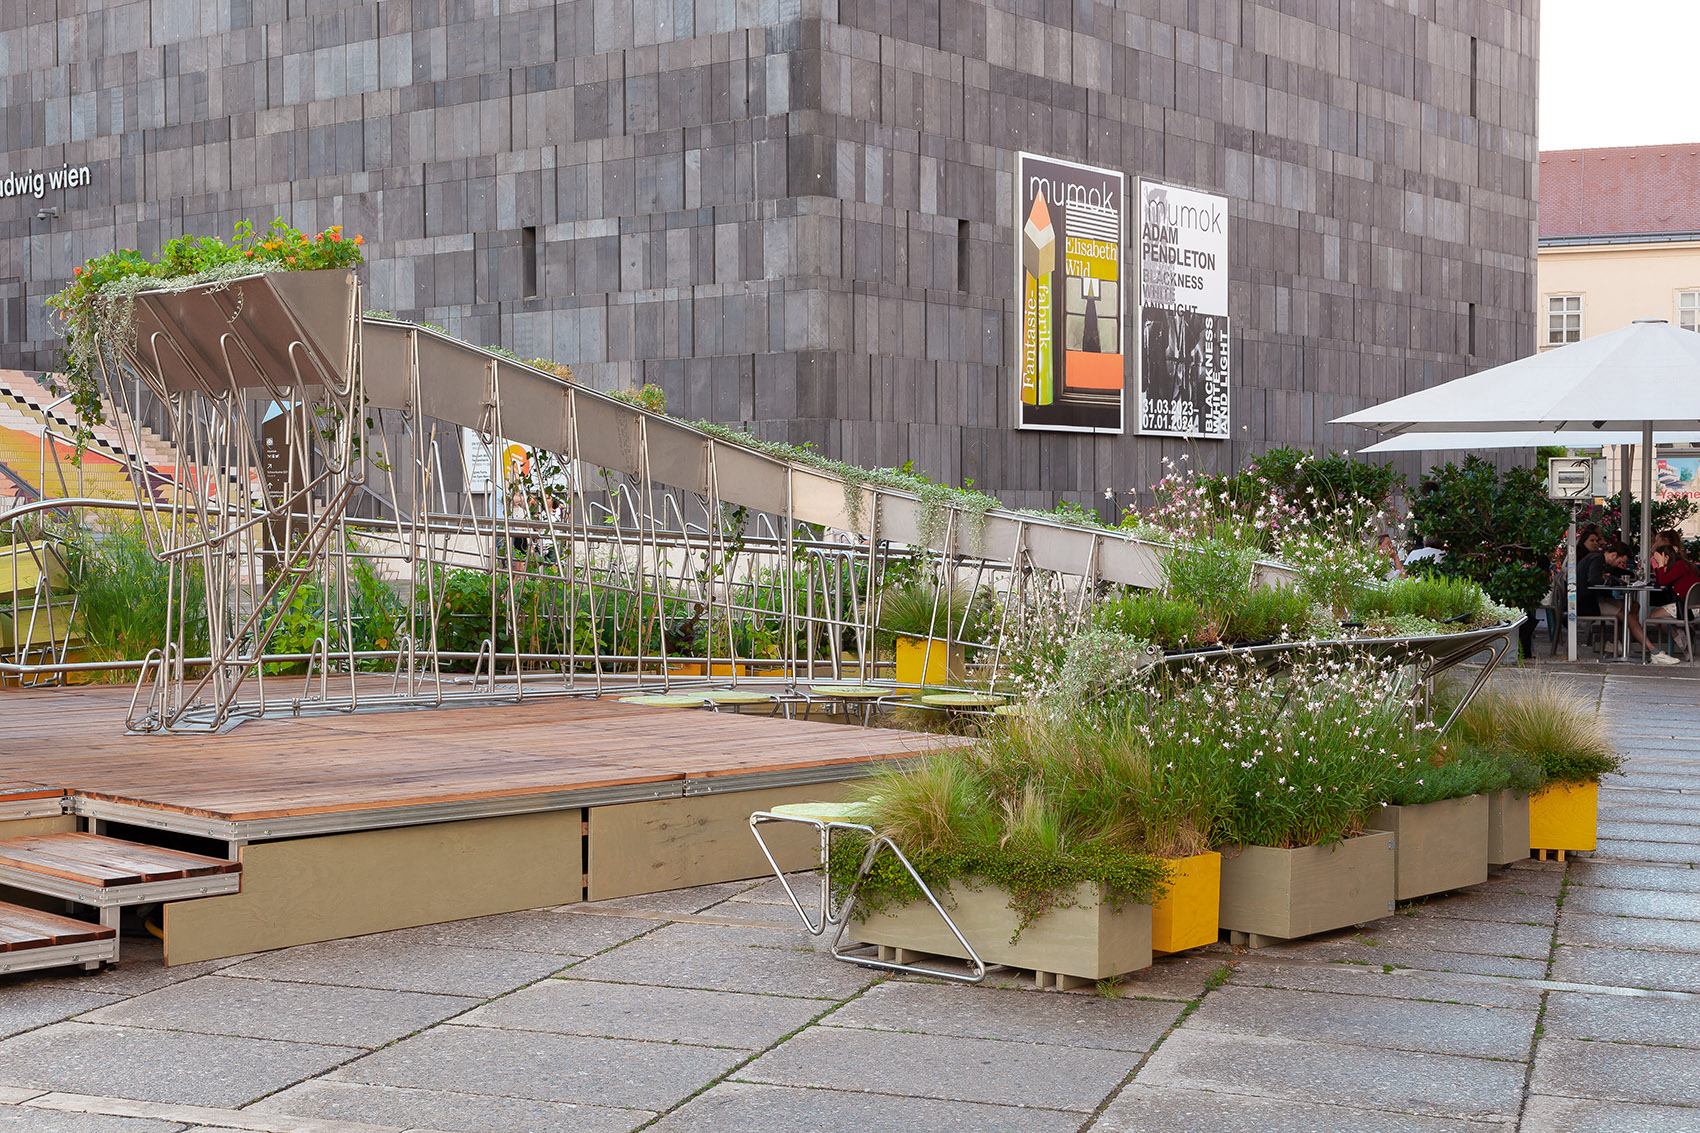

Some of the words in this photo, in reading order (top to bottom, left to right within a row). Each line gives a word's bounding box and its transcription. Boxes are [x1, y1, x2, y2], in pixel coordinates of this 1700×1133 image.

[49, 163, 90, 190] wien
[1030, 176, 1114, 216] mumok
[1142, 222, 1178, 245] ADAM
[1148, 199, 1222, 235] mumok
[1066, 236, 1117, 261] Elisabeth
[1143, 243, 1216, 271] PENDLETON
[1066, 258, 1090, 278] Wild
[1143, 269, 1204, 291] BLACKNESS
[1038, 284, 1051, 350] fabrik
[1023, 290, 1037, 390] Fantasie-
[1220, 330, 1228, 388] LIGHT
[1205, 316, 1214, 432] BLACKNESS
[1213, 371, 1221, 433] WHITE
[1220, 393, 1228, 434] AND
